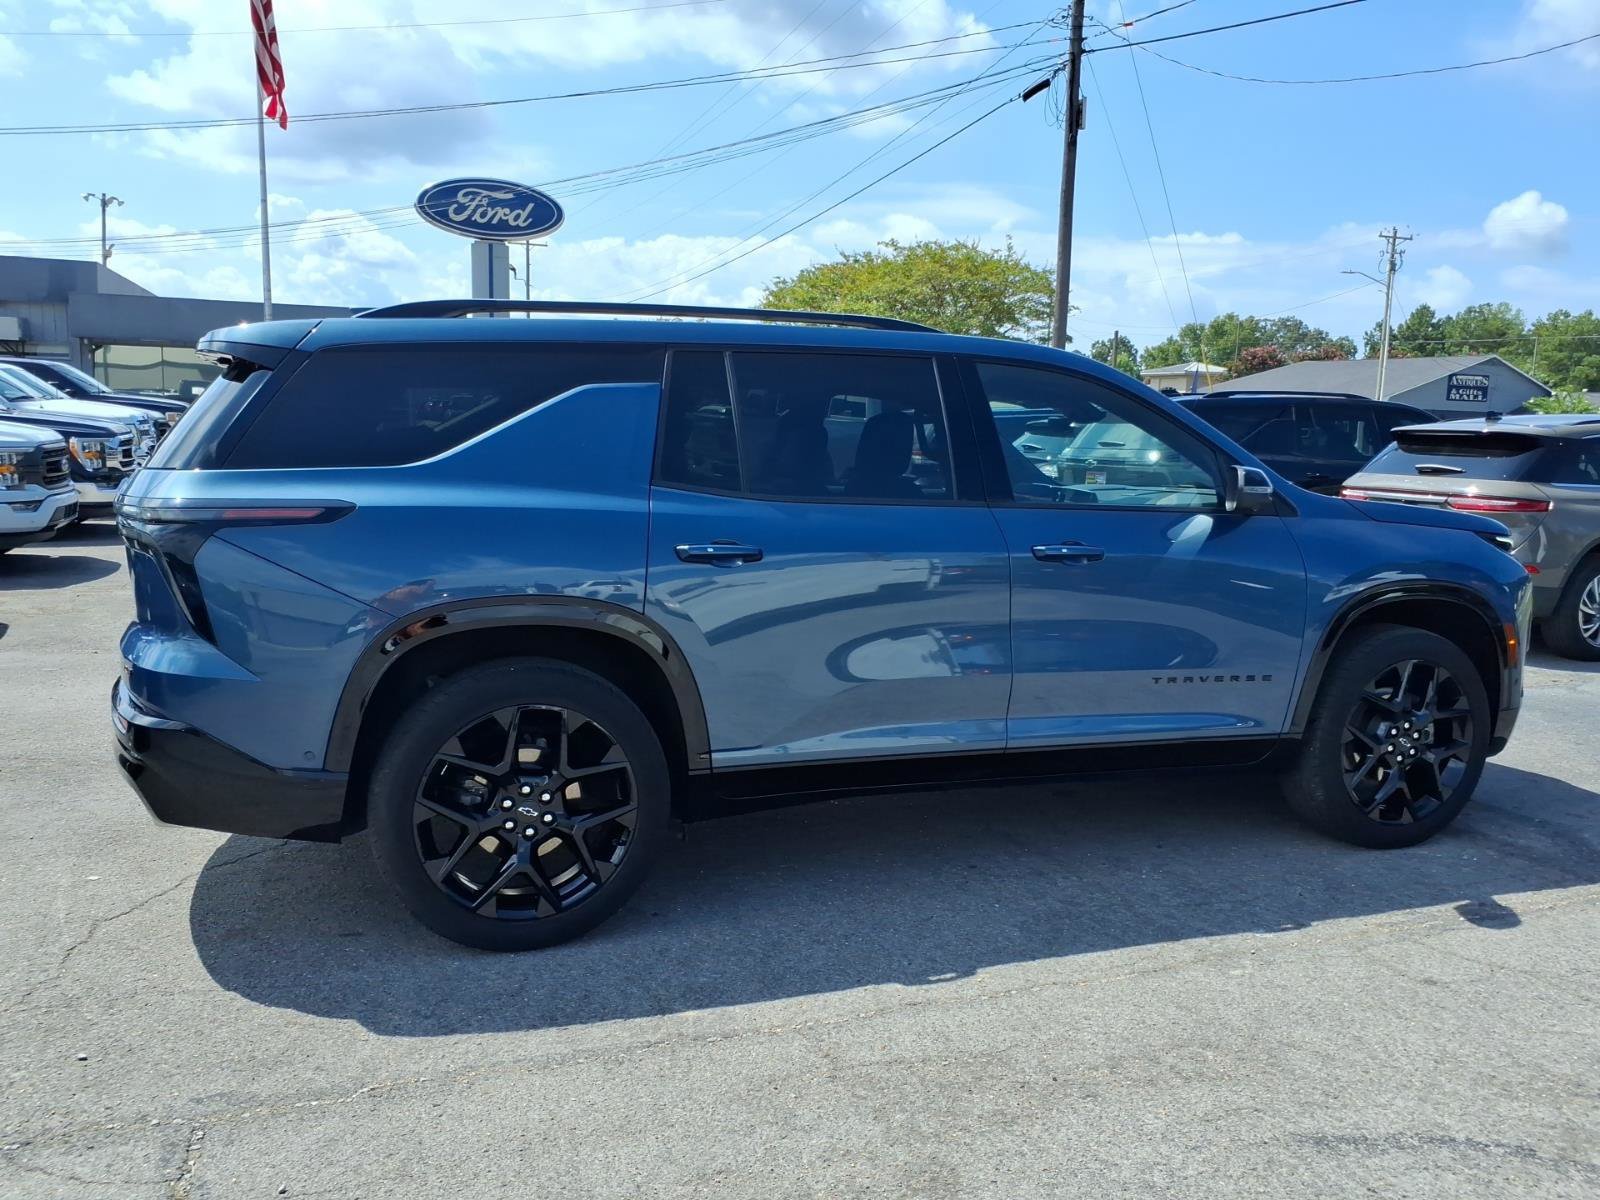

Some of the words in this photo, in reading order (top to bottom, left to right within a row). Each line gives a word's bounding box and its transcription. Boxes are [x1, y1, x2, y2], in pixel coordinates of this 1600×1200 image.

[448, 188, 535, 227] Ford
[1450, 375, 1489, 387] ANTIQUES
[1152, 674, 1273, 685] TRAVERSE
